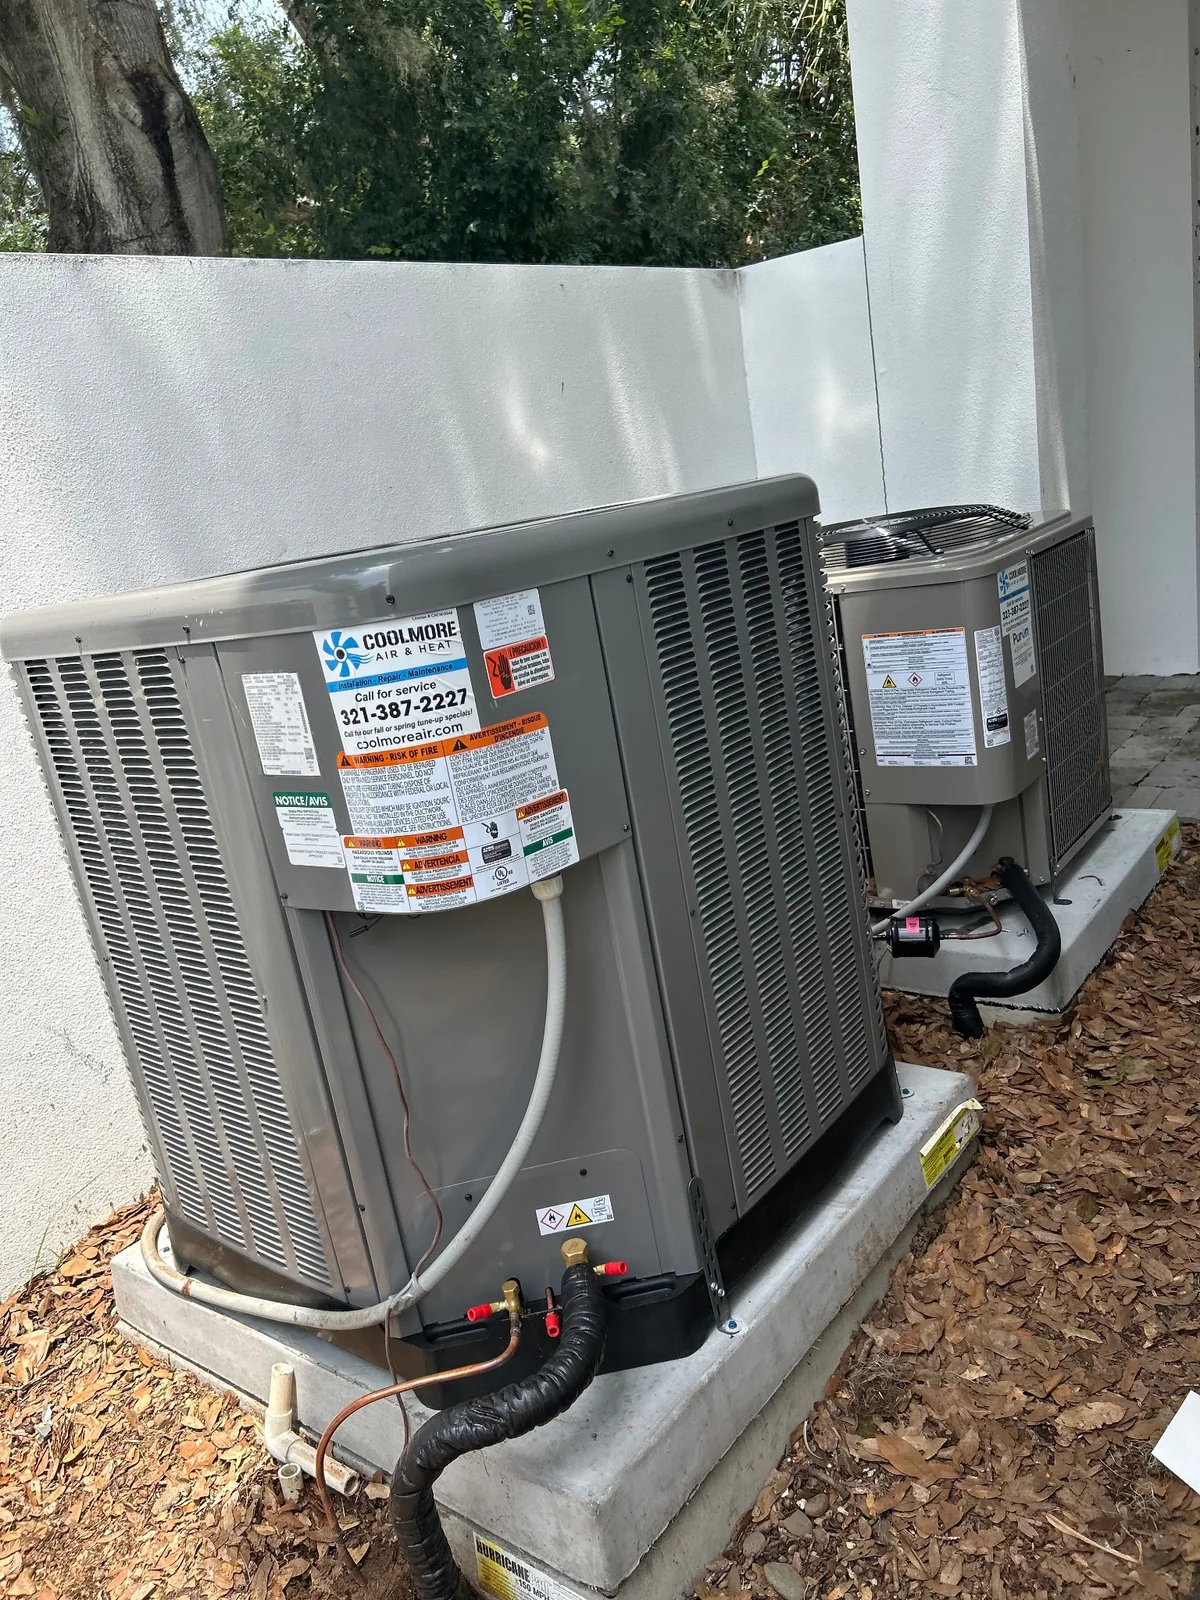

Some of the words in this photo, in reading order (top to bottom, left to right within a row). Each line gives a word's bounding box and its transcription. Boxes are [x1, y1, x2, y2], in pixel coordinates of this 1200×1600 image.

[362, 621, 457, 650] COOLMORE
[376, 650, 398, 661] AIR
[404, 647, 413, 656] &
[419, 640, 451, 653] HEAT
[338, 678, 372, 690] Installation
[378, 673, 401, 683] Repair
[408, 663, 453, 677] Maintenance
[355, 691, 374, 703] Call
[377, 688, 393, 699] for
[395, 681, 437, 696] service
[340, 688, 467, 726] 321-387-2227
[344, 730, 354, 738] Call
[374, 725, 384, 734] fall
[394, 721, 416, 732] spring
[417, 715, 444, 727] tune-up
[445, 708, 473, 721] specials!
[469, 722, 517, 741] AVERTISSEMENT
[521, 714, 542, 725] RISQUE
[356, 722, 463, 750] coolmoreair.com
[494, 727, 525, 742] D'INCENDIE
[354, 754, 384, 764] WARNING
[389, 751, 408, 761] RISK
[408, 749, 419, 758] OF
[420, 746, 439, 756] FIRE
[404, 779, 423, 788] DISPOSE
[423, 777, 431, 785] OF
[415, 770, 423, 778] DO
[423, 768, 435, 776] NOT
[405, 786, 426, 796] FEDERAL
[433, 781, 449, 791] LOCAL
[274, 796, 328, 807] NOTICE/AVIS
[415, 832, 447, 845] WARNING
[542, 836, 554, 848] AVIS
[414, 854, 461, 870] ADVERTENCIA
[476, 1540, 530, 1583] HURRICANE
